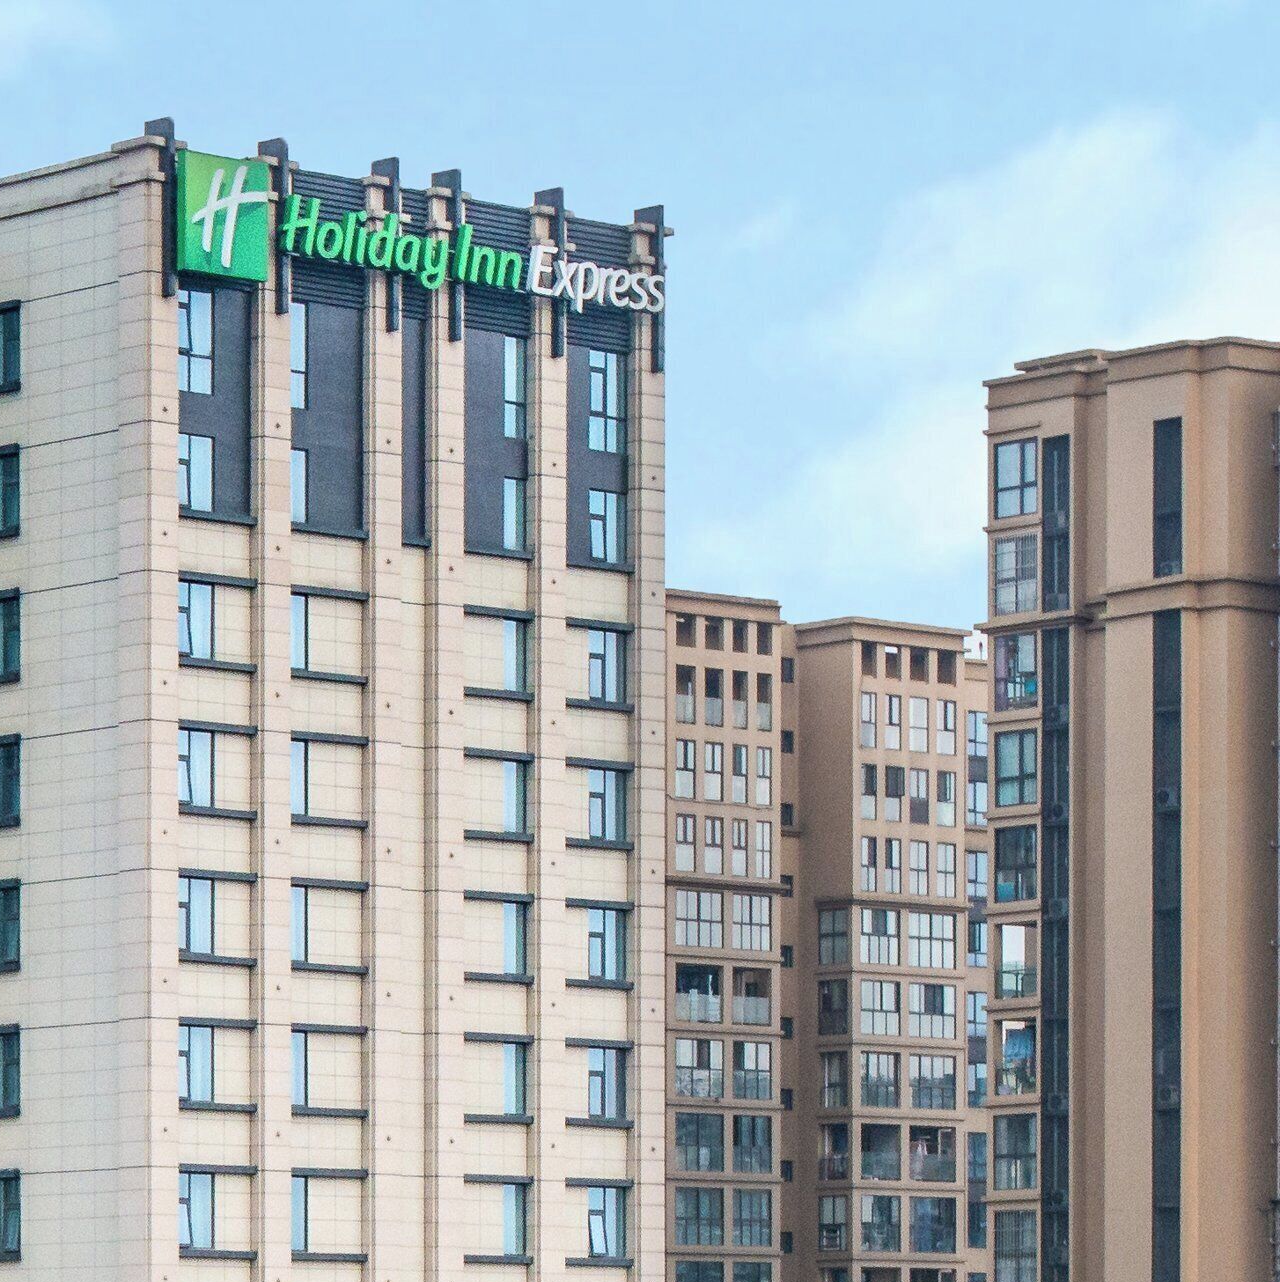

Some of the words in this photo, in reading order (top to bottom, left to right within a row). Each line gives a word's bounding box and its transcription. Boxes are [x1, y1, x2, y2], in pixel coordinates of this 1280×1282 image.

[281, 193, 448, 290] Holiday
[452, 223, 522, 290] Inn
[527, 244, 665, 313] Express
